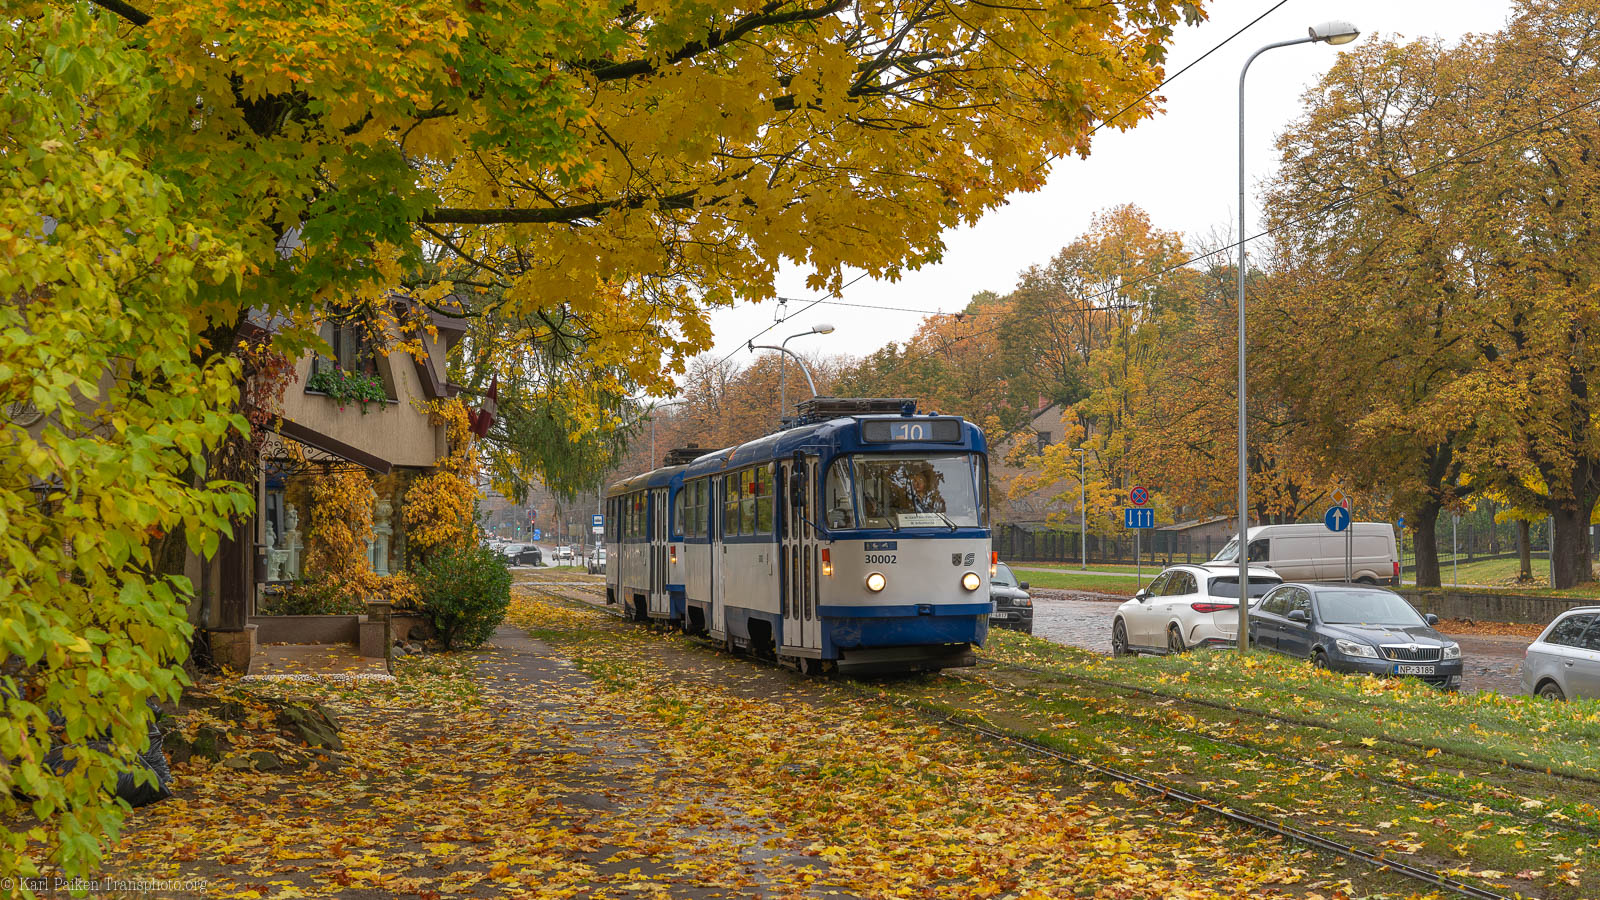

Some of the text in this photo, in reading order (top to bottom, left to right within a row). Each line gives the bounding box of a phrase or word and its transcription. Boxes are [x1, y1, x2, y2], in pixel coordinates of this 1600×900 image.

[900, 423, 923, 440] 10
[864, 554, 897, 564] 30002
[1399, 665, 1434, 674] NP-3185
